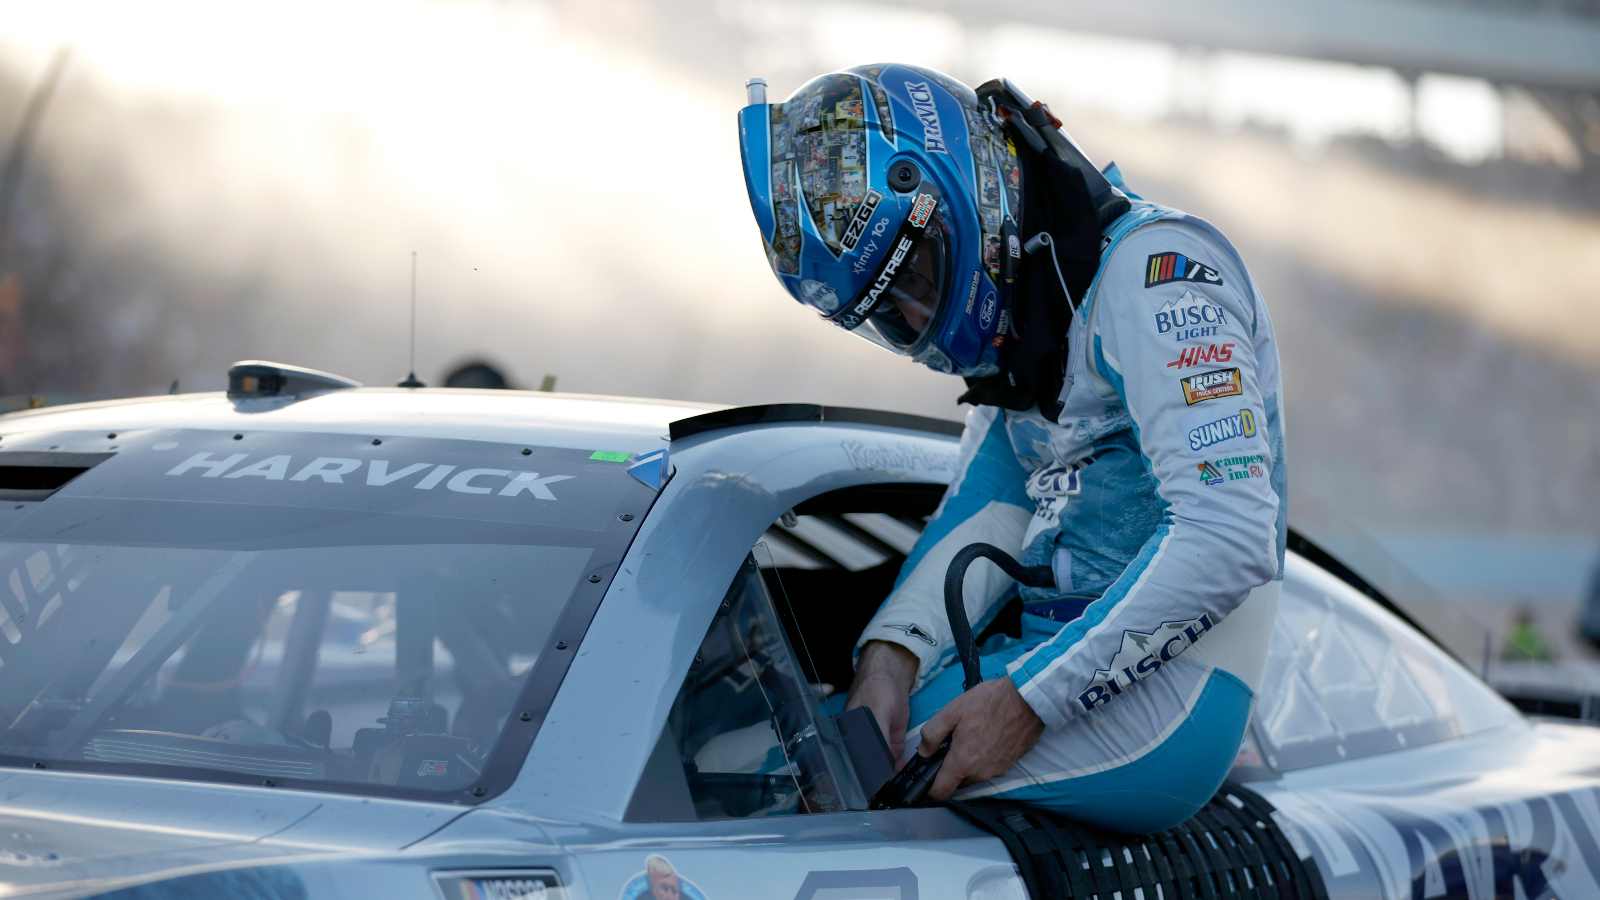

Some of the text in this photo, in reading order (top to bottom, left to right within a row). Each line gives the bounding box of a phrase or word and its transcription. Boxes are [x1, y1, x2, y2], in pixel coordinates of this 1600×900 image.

[904, 81, 948, 154] HARVICK
[852, 240, 878, 275] xfinity
[854, 236, 913, 315] REALTREE
[981, 298, 995, 323] Ford
[1154, 304, 1228, 334] BUSCH
[1175, 326, 1218, 341] LIGHT
[1166, 343, 1235, 370] HAAS
[1195, 385, 1234, 398] TRUCK CENTERS
[166, 451, 577, 501] HARVICK
[1227, 468, 1250, 481] inn
[1077, 612, 1215, 711] BUSCH
